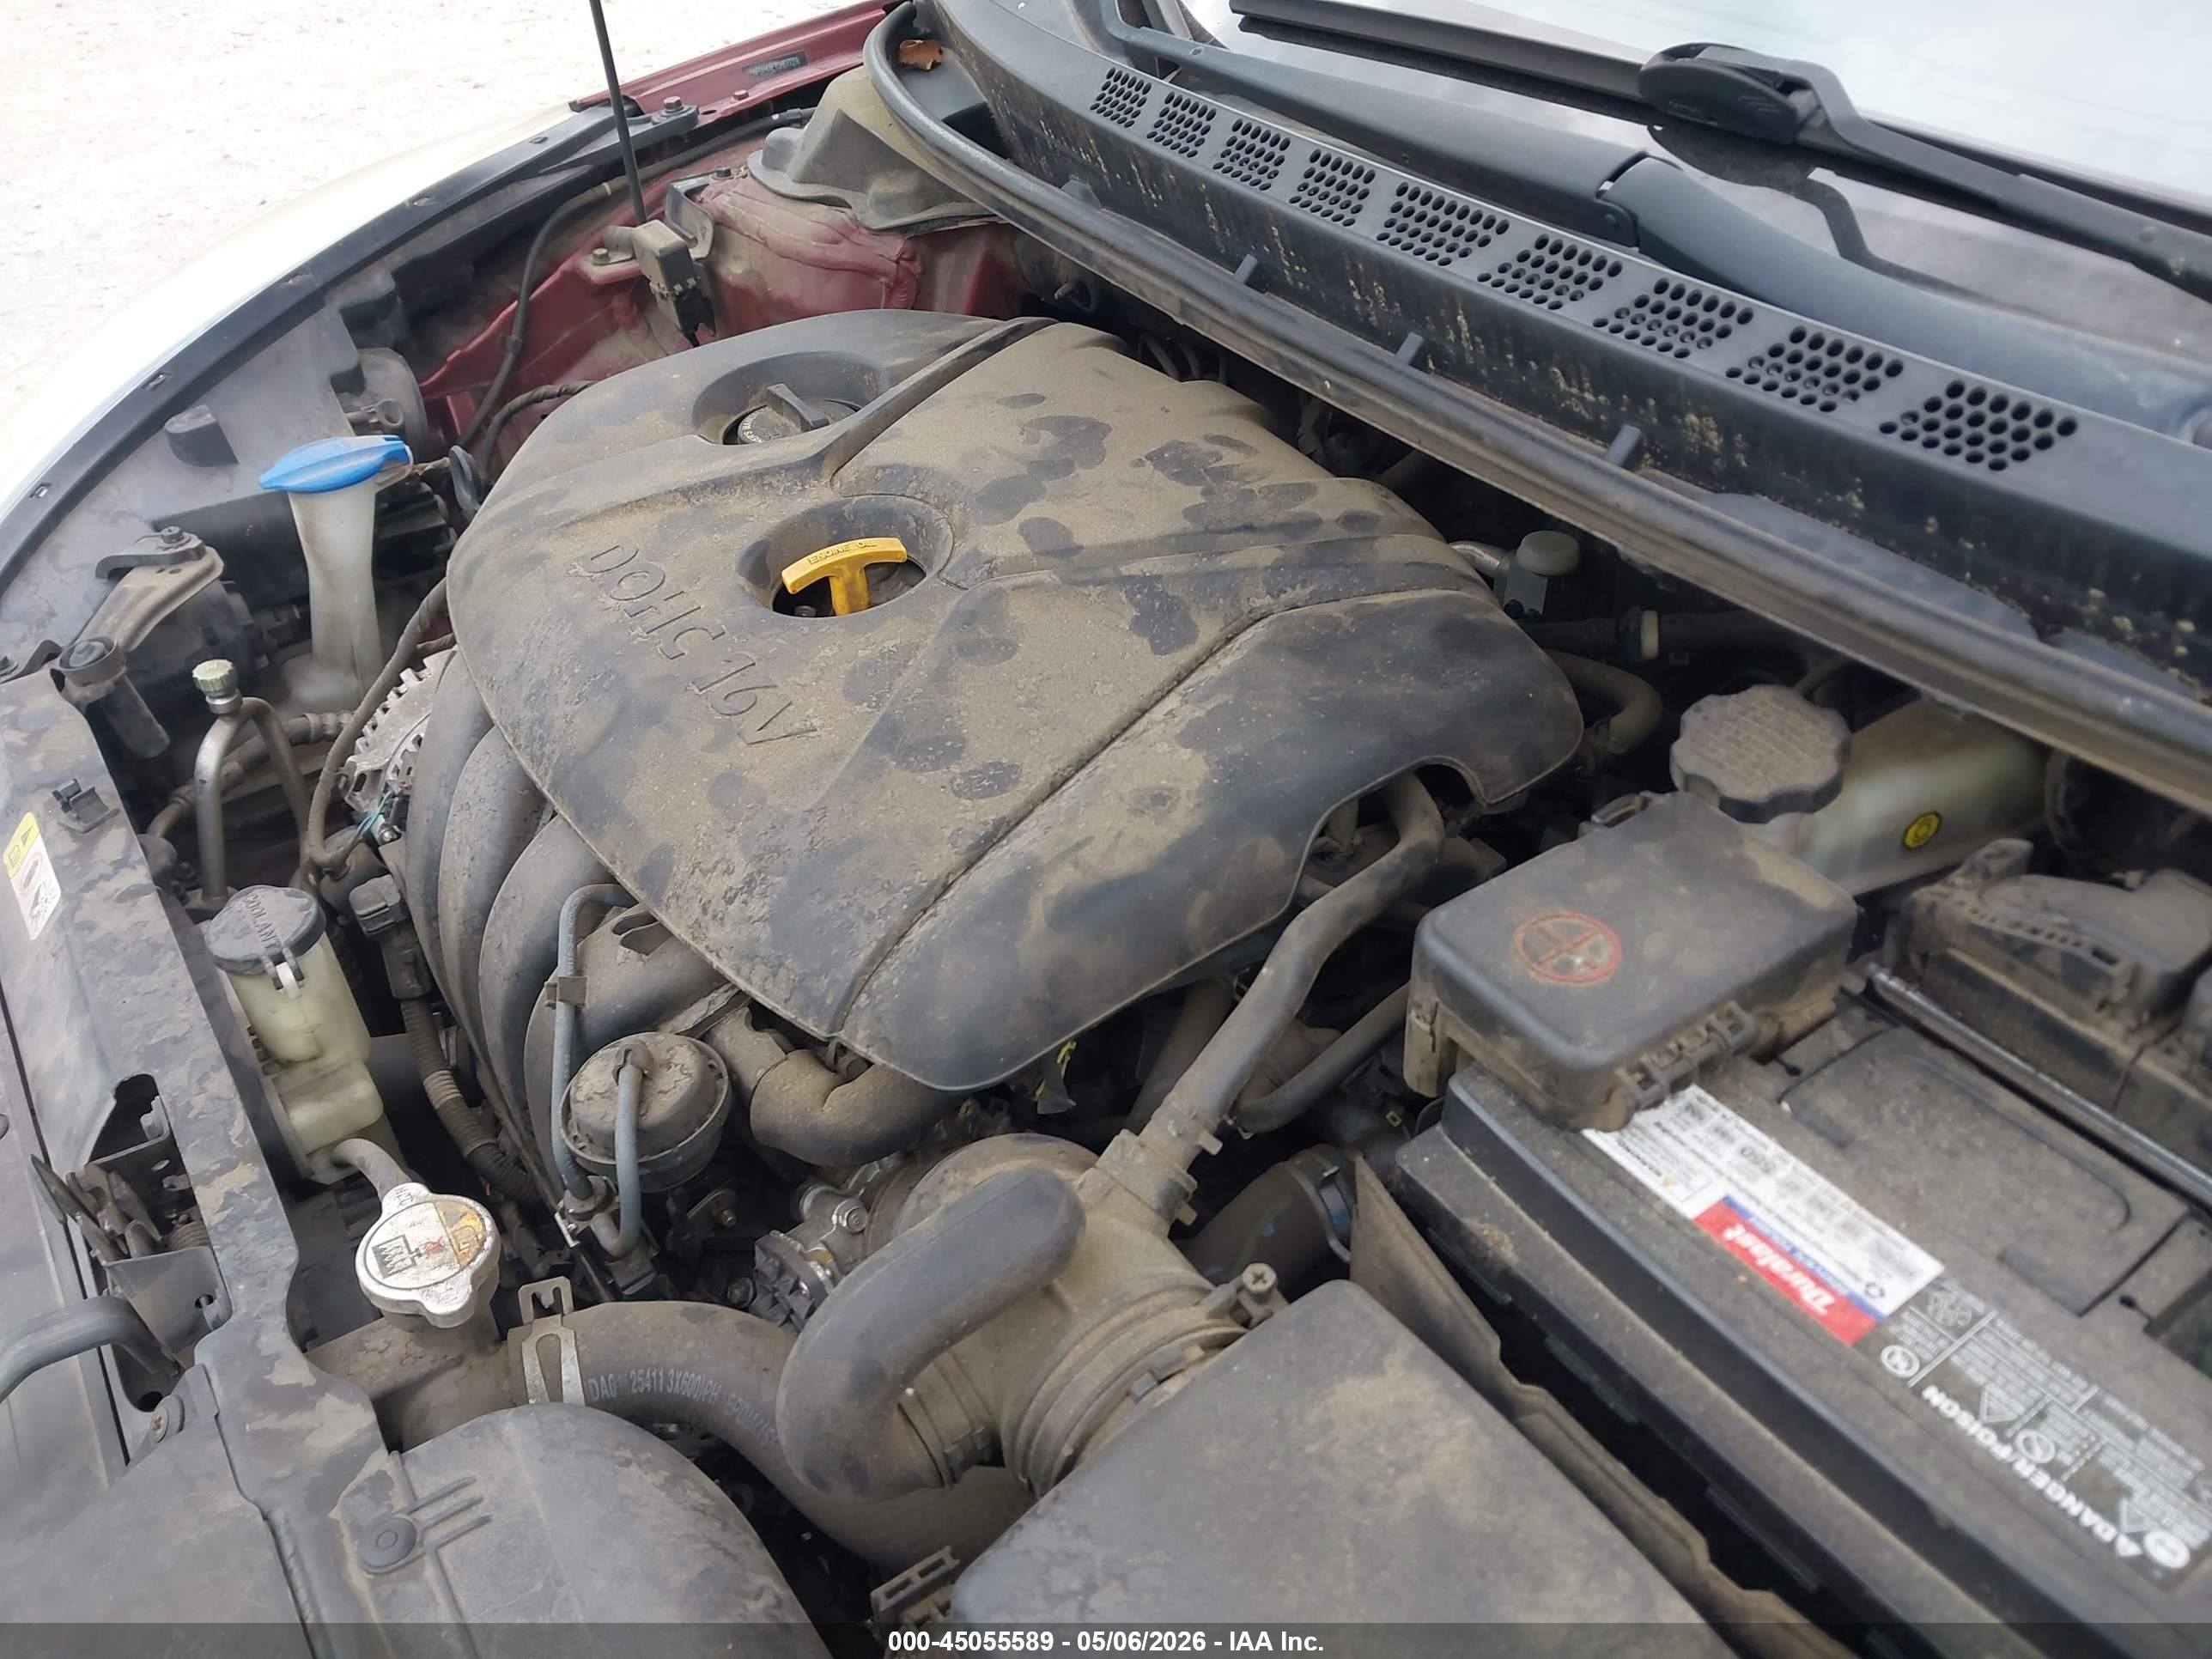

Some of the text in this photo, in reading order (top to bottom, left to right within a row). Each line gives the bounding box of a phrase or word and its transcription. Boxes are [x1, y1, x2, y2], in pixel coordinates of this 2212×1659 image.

[806, 537, 877, 566] ENGINE OIL
[571, 544, 818, 746] DOHC 16V
[245, 893, 282, 949] COOLANT
[1720, 1223, 1837, 1316] Duralast
[1920, 1383, 2118, 1545] DANGER/POISON
